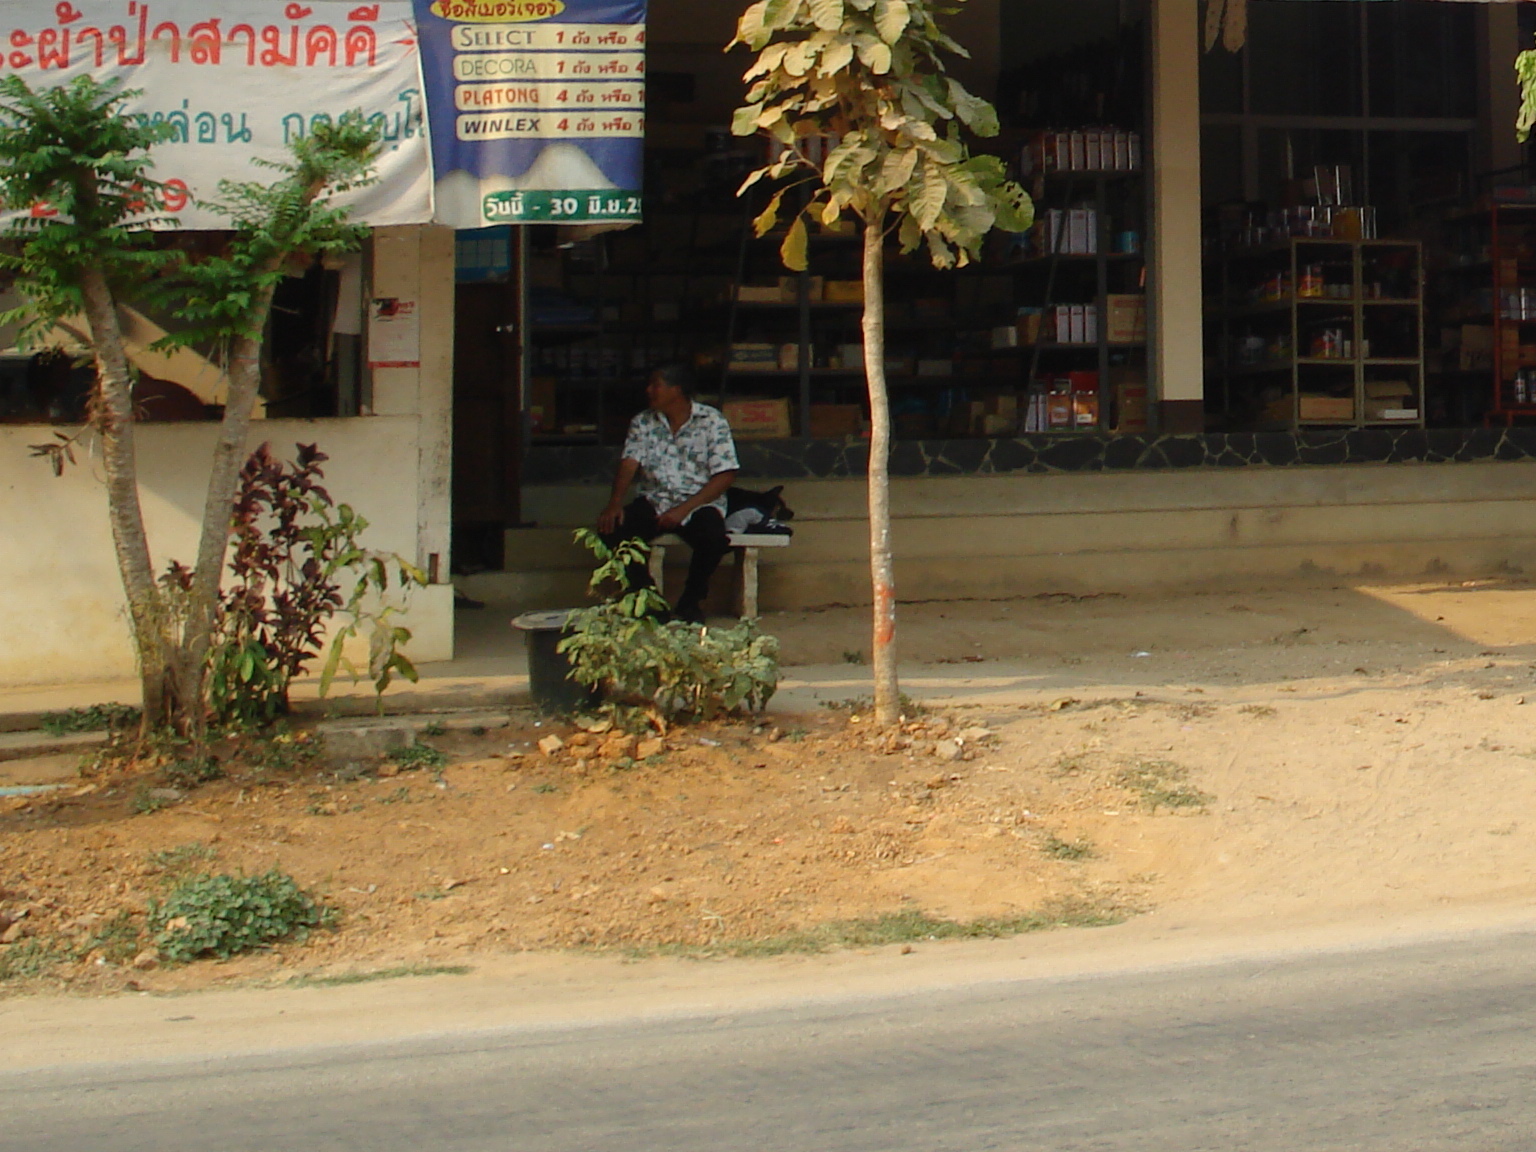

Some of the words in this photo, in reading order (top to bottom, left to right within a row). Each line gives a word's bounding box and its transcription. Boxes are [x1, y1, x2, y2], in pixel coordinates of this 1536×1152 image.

[0, 0, 380, 69] ะผ้าป่าสามัคคี
[460, 27, 536, 47] SELECT
[556, 31, 565, 44] 1
[461, 59, 537, 77] DECORA
[556, 61, 565, 74] 1
[462, 88, 540, 106] PLATONG
[556, 90, 569, 104] 4
[464, 118, 541, 135] WINLEX
[557, 118, 569, 132] 4
[550, 197, 579, 215] 30
